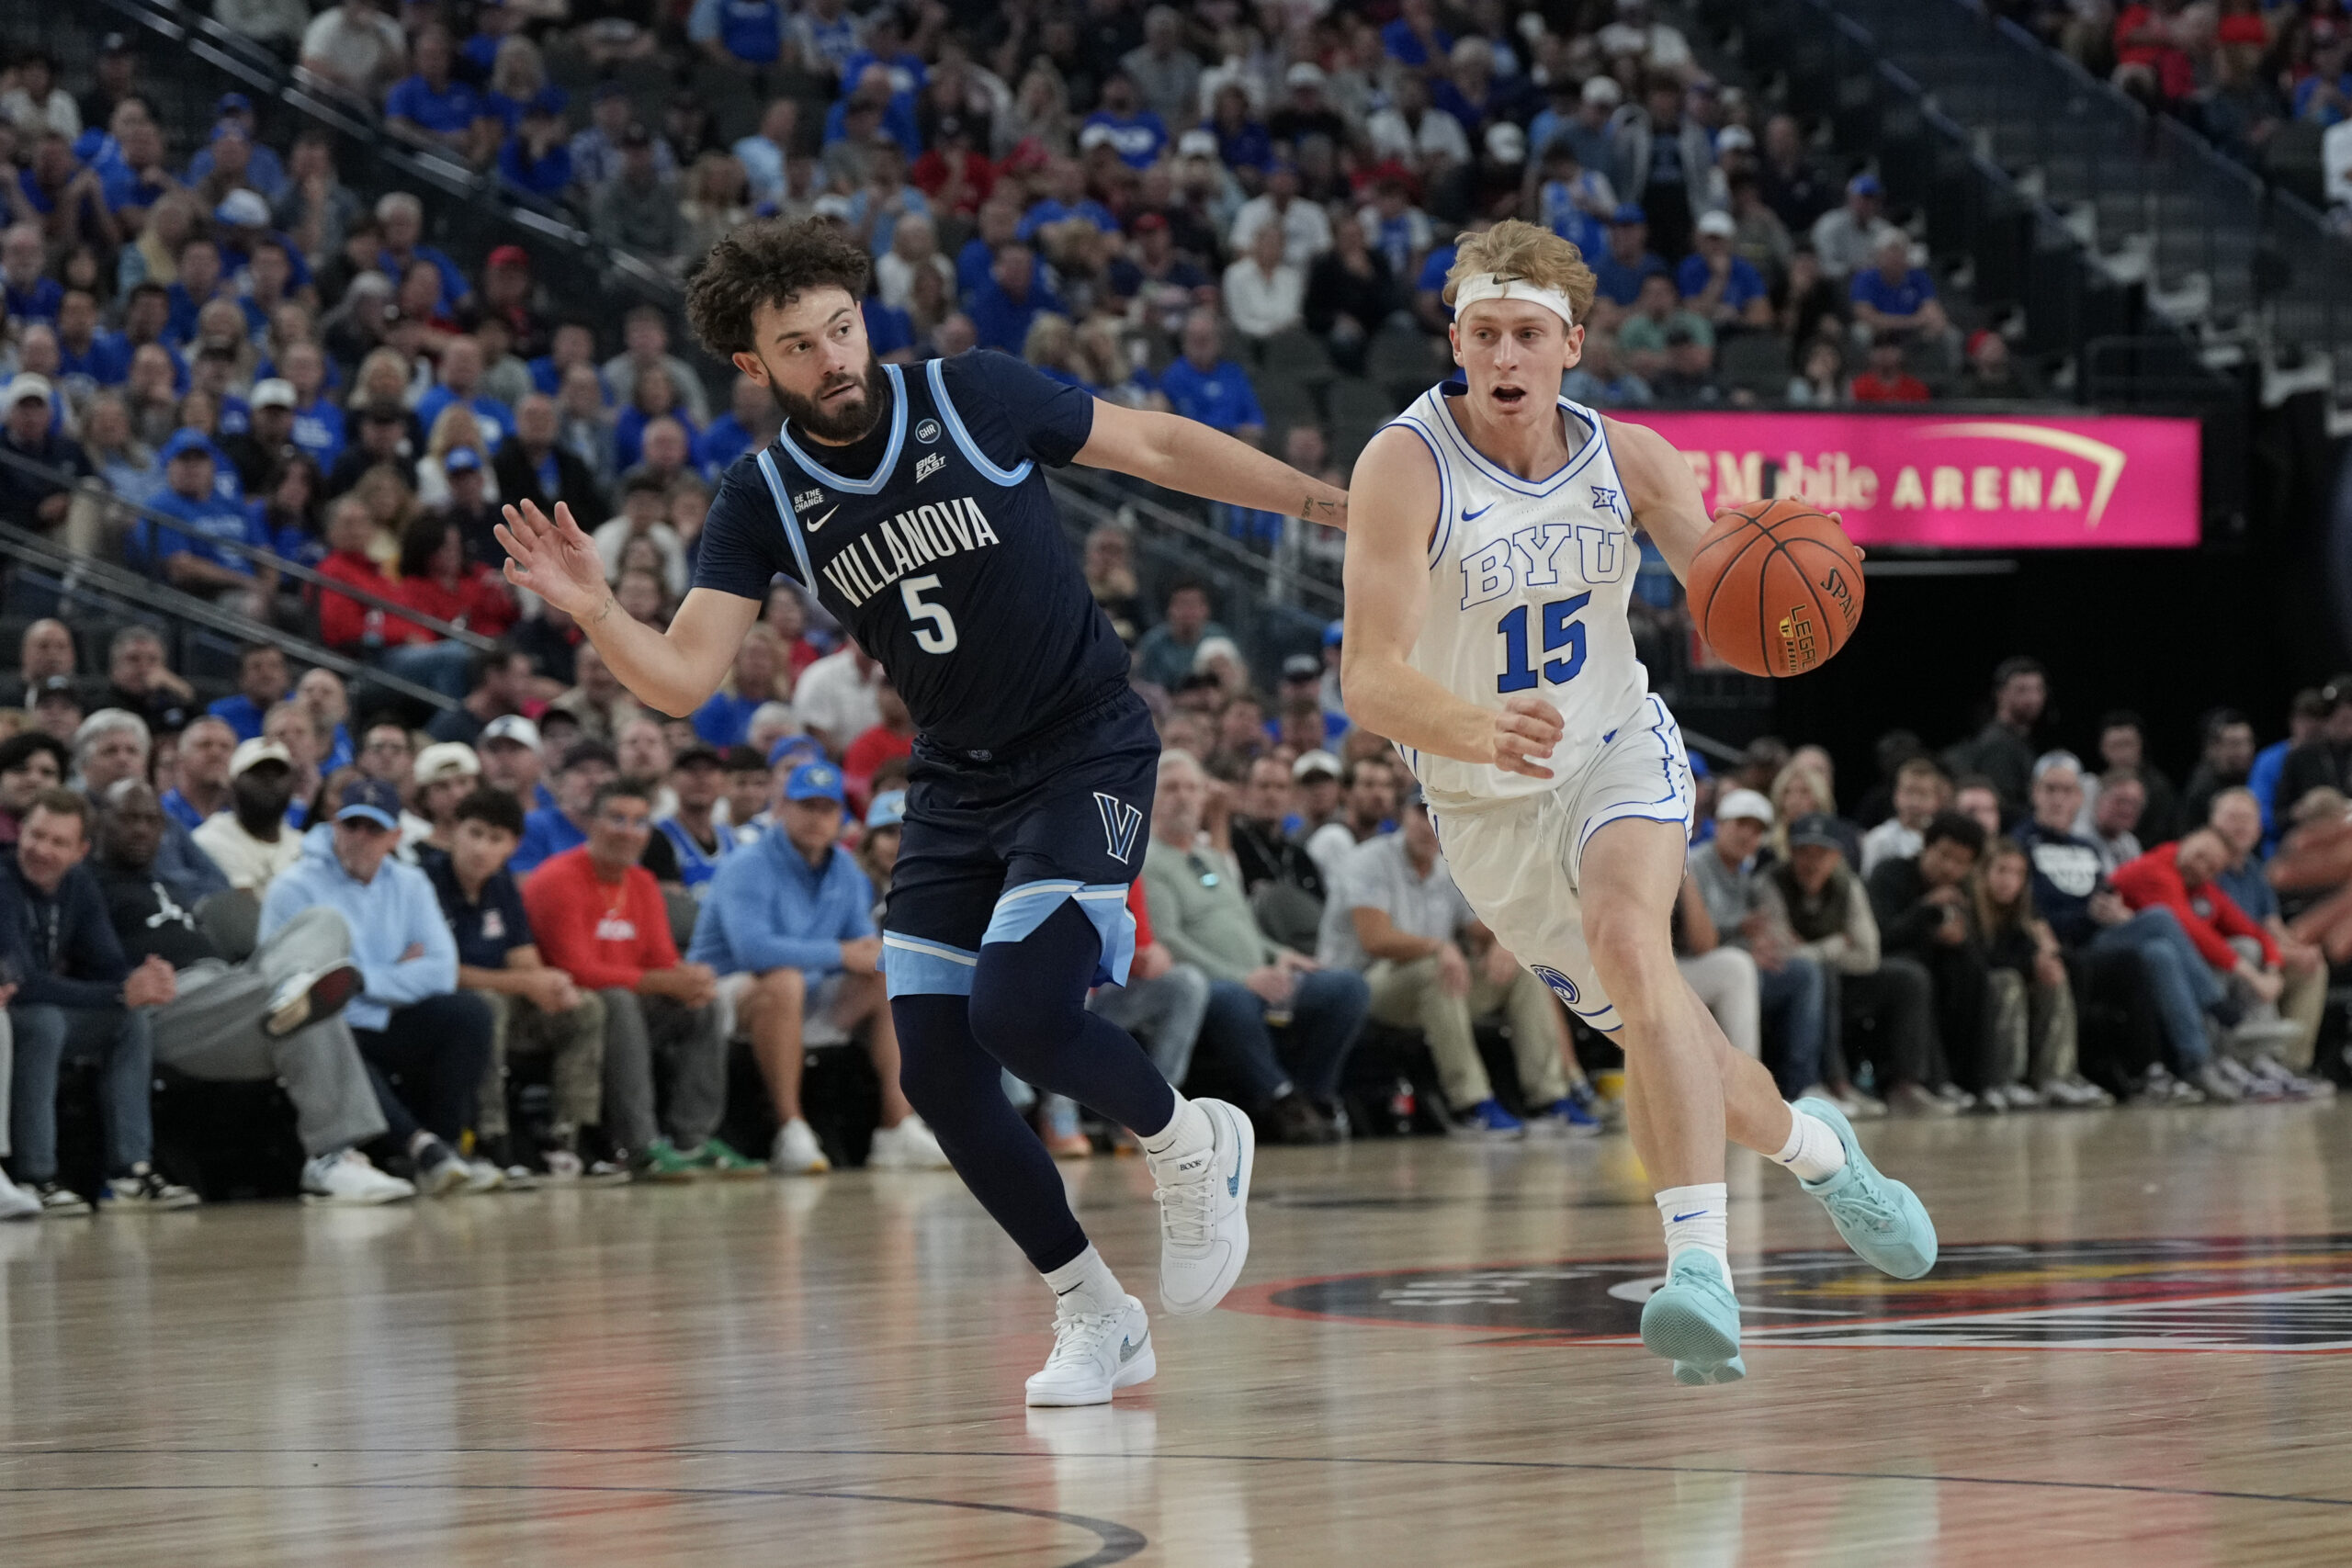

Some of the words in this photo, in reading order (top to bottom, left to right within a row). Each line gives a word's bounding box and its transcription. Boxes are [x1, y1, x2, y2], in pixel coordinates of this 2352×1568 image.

[919, 423, 936, 439] GHR
[916, 452, 937, 470] BIG
[916, 456, 946, 479] EAST
[794, 493, 805, 504] BE
[805, 488, 821, 500] THE
[1891, 466, 2083, 511] ARENA
[794, 494, 825, 513] CHANGE
[822, 496, 1001, 608] VILLANOVA
[1461, 524, 1626, 611] BYU
[899, 573, 958, 655] 5
[1498, 589, 1592, 694] 15
[1180, 1158, 1203, 1171] BOOK
